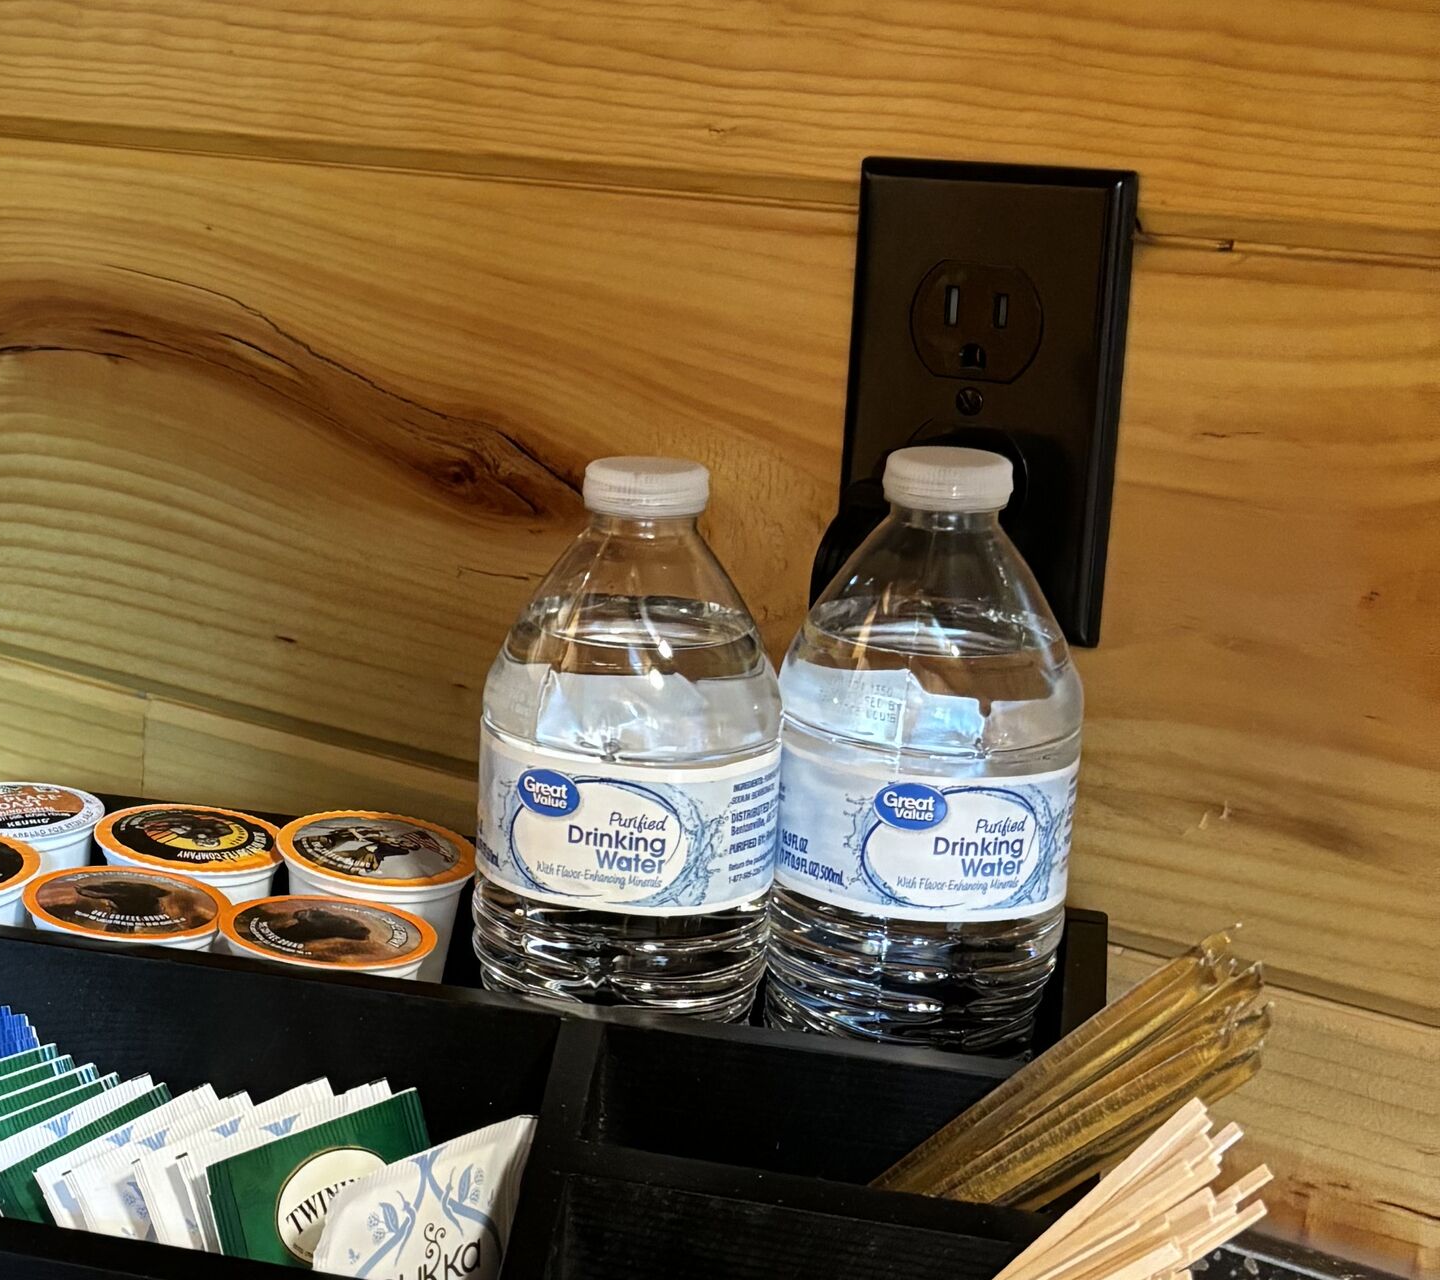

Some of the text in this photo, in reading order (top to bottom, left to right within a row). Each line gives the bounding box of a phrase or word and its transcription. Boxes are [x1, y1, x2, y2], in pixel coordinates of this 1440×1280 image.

[523, 775, 568, 799] Great
[532, 792, 568, 809] Value
[883, 791, 935, 811] Great
[6, 817, 50, 827] KEURIG
[609, 811, 669, 834] Purified
[895, 806, 934, 821] Value
[976, 815, 1028, 837] Purified
[568, 824, 666, 857] Drinking
[933, 836, 1024, 858] Drinking
[596, 849, 666, 874] Water
[961, 857, 1024, 877] Water
[536, 860, 662, 889] With Flavor-Enhancing Minerals
[896, 875, 1020, 895] With Flavor-Enhancing Minerals
[285, 1177, 360, 1235] TWIN
